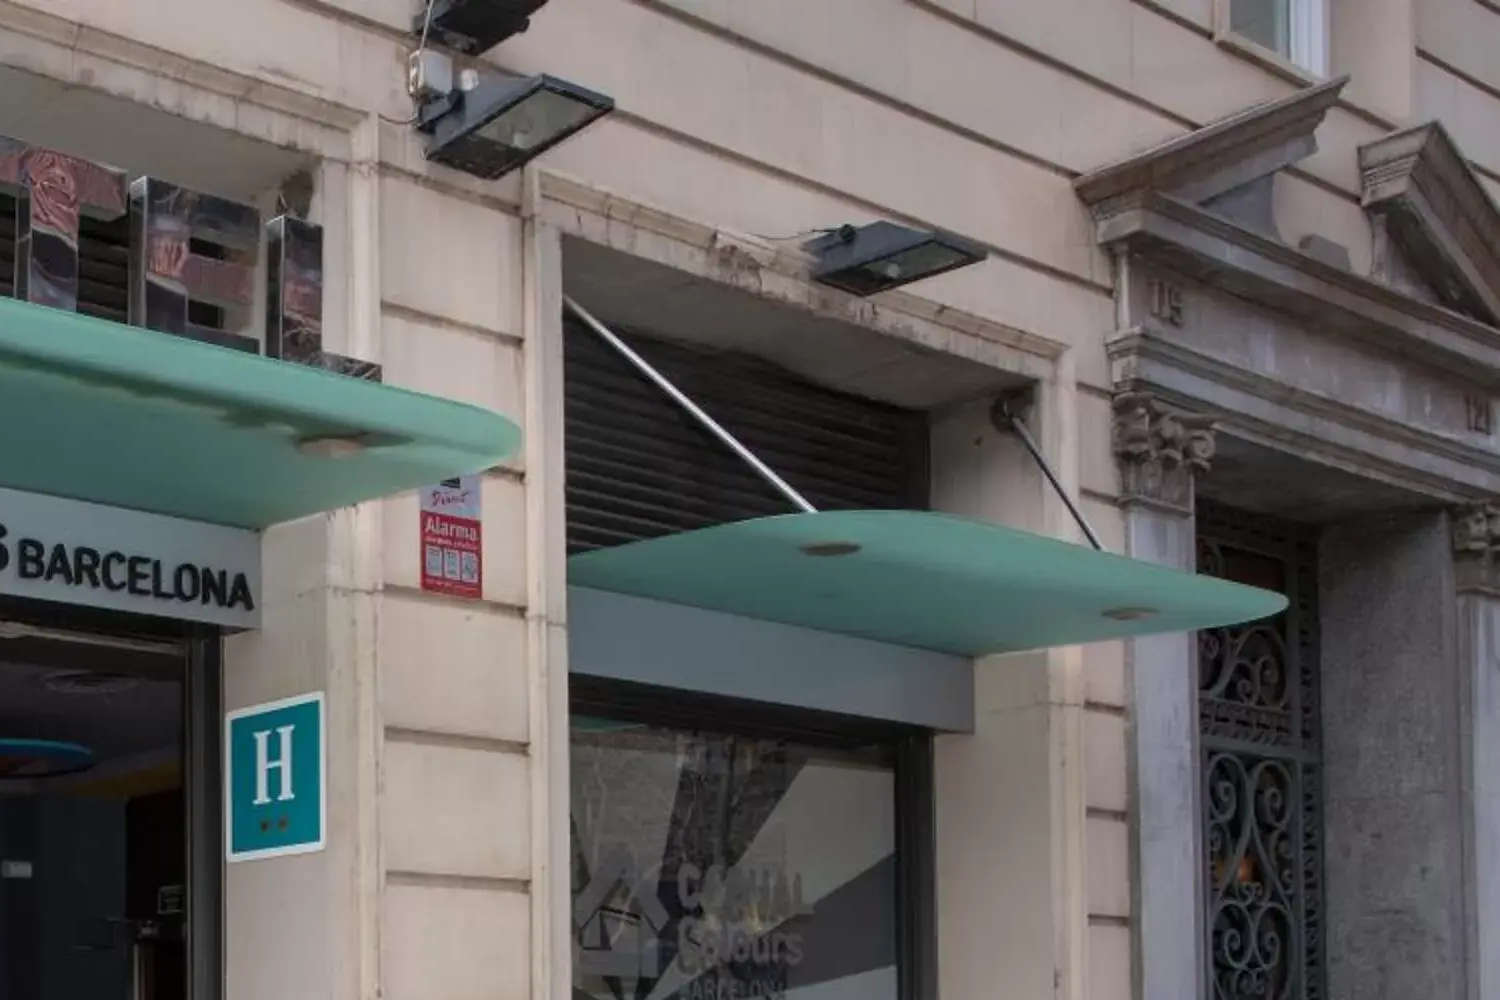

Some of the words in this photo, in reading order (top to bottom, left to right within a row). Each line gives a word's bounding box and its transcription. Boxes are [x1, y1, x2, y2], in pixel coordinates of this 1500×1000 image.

[424, 515, 479, 542] Alarma
[17, 538, 255, 611] BARCELONA
[252, 723, 296, 806] H
